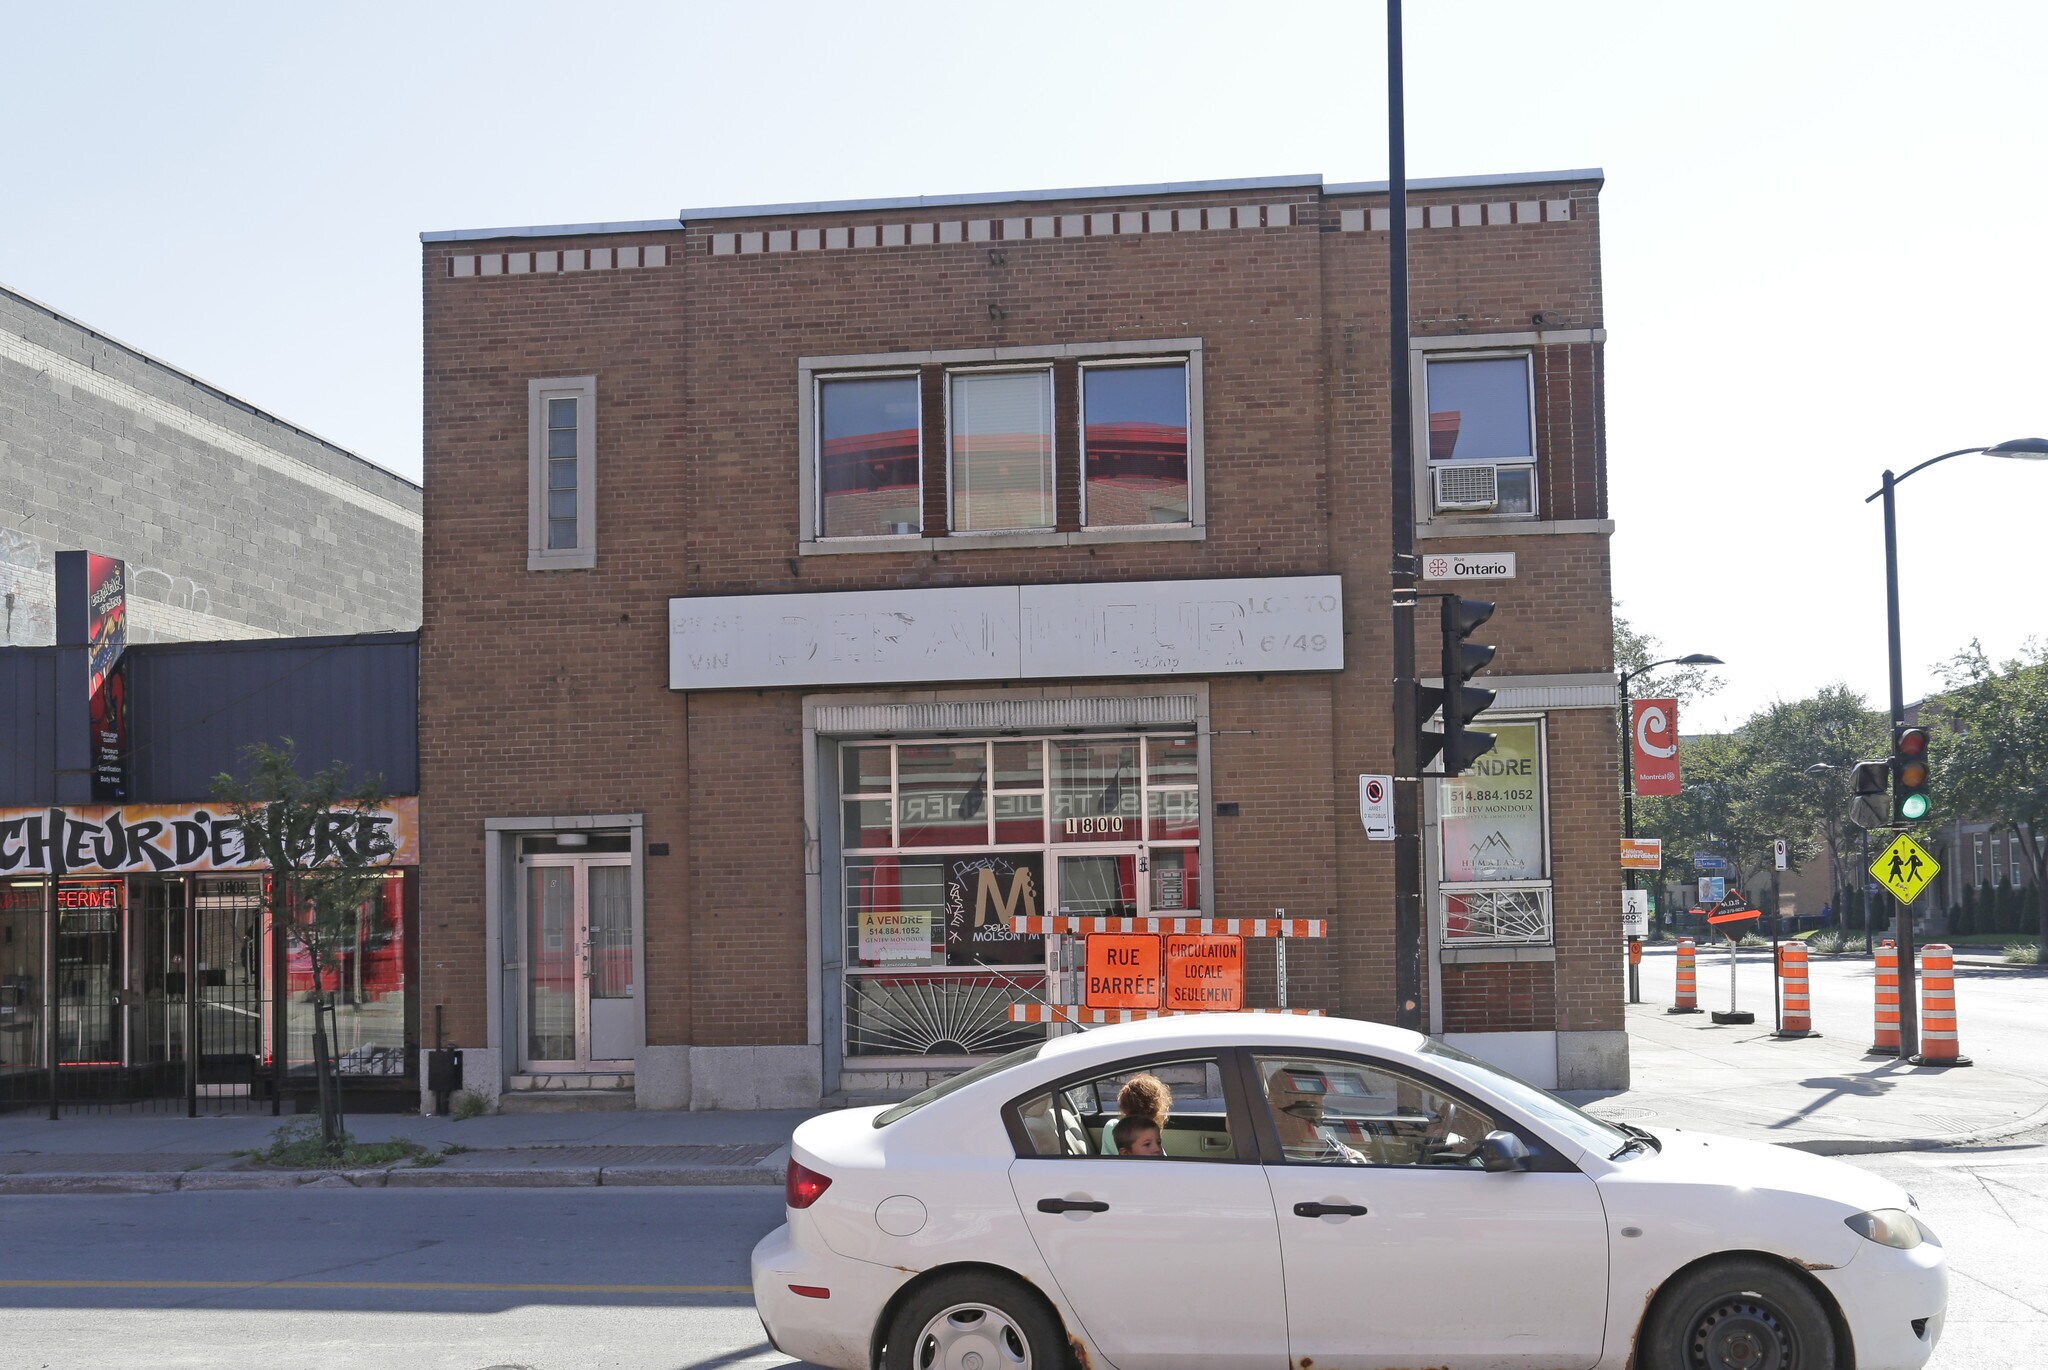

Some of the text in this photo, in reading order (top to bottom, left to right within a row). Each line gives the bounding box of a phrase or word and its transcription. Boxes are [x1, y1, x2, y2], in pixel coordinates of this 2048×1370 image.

[1454, 562, 1507, 575] Ontario
[1465, 758, 1532, 776] ENDRE
[1639, 771, 1667, 781] Montréal
[1451, 789, 1533, 801] 514.884.1052
[1450, 804, 1534, 814] GENIEV MONDOUX
[1068, 816, 1123, 833] 1800
[1461, 858, 1525, 867] HIMALAYA
[866, 914, 923, 925] À VENDRE
[869, 927, 920, 935] 514.884.1052
[973, 932, 1021, 942] MOLSON
[1107, 948, 1140, 966] RUE
[1170, 944, 1237, 958] CIRCULATION
[1185, 964, 1223, 979] LOCALE
[1091, 974, 1155, 995] BARRÉE
[1174, 987, 1233, 1002] SEULEMENT
